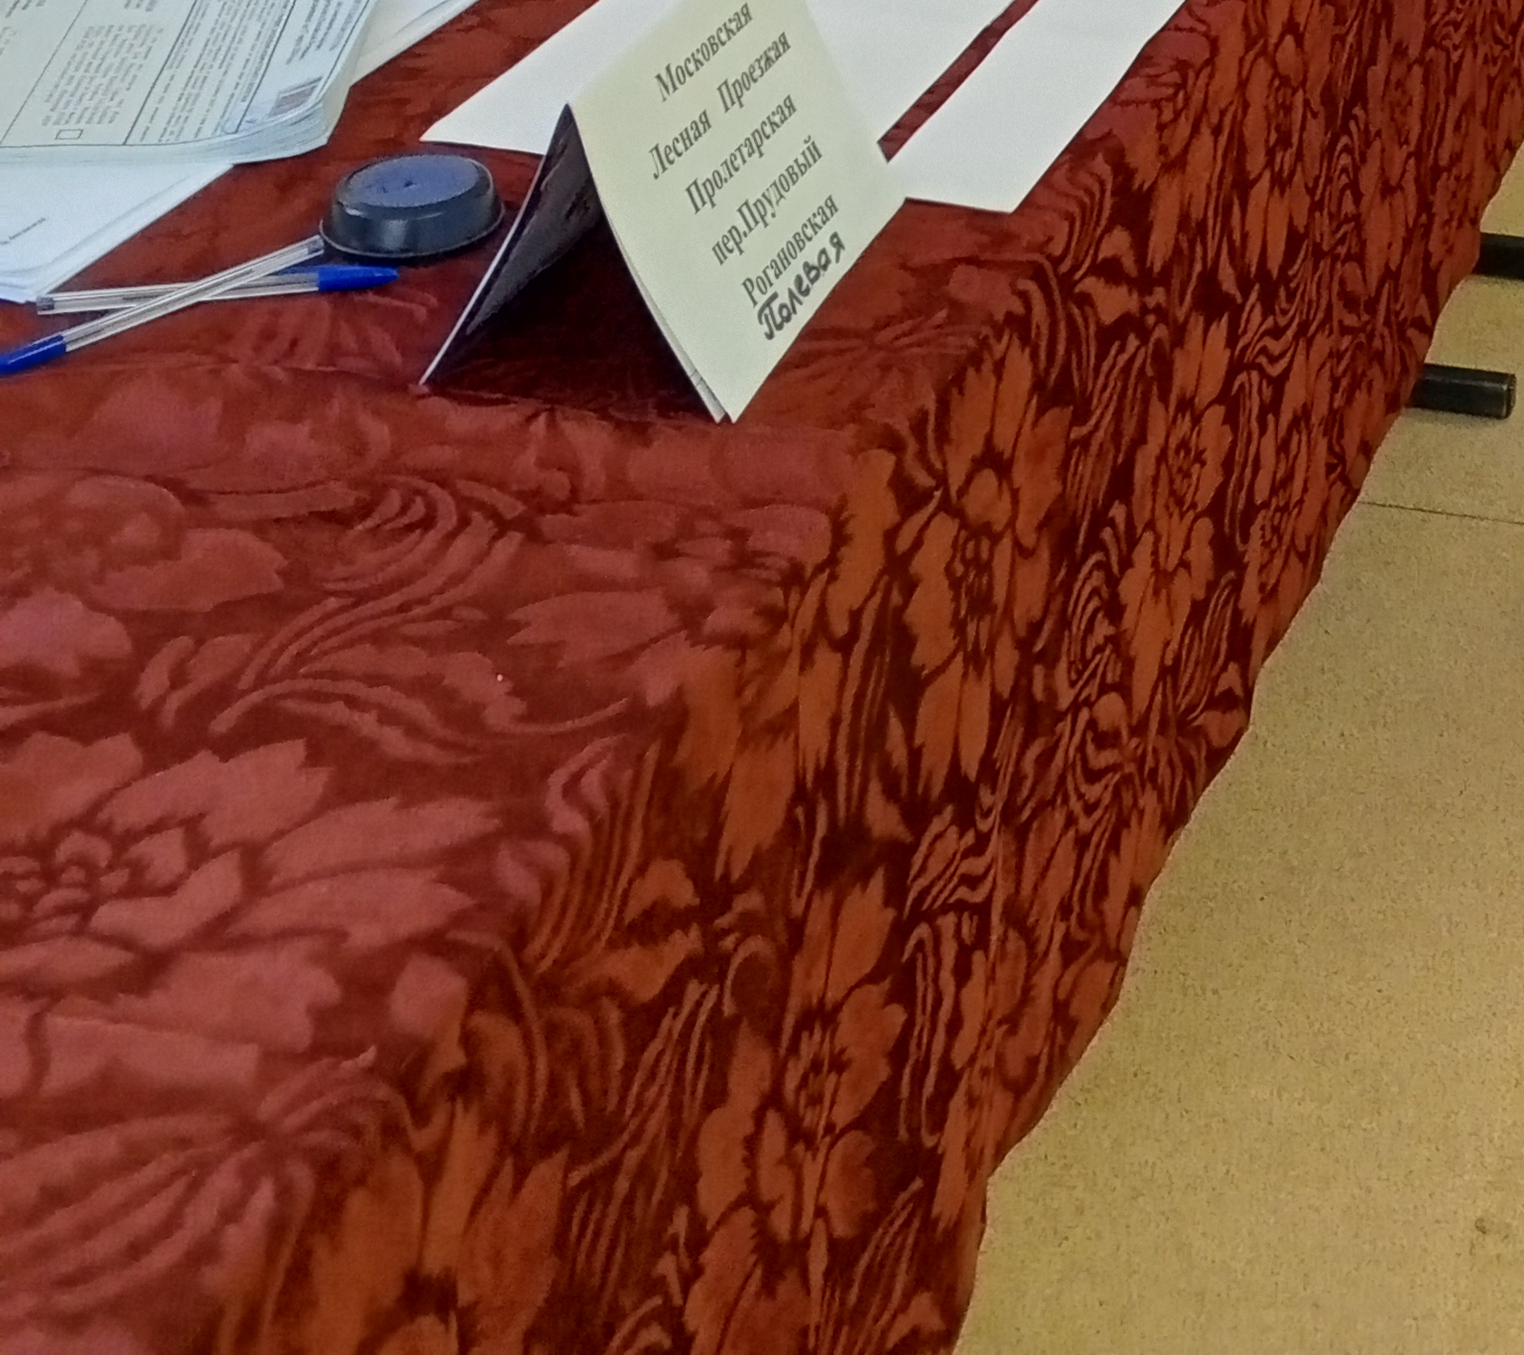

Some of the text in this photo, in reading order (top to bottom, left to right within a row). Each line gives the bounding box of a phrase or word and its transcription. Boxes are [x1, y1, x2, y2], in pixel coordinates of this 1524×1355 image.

[649, 31, 791, 179] Лесная Проезжая
[654, 2, 753, 102] Московская
[684, 94, 797, 214] Пролетарская
[711, 135, 823, 266] пер.Прудовый
[741, 194, 839, 308] Рогановская
[757, 231, 846, 340] Полевая
